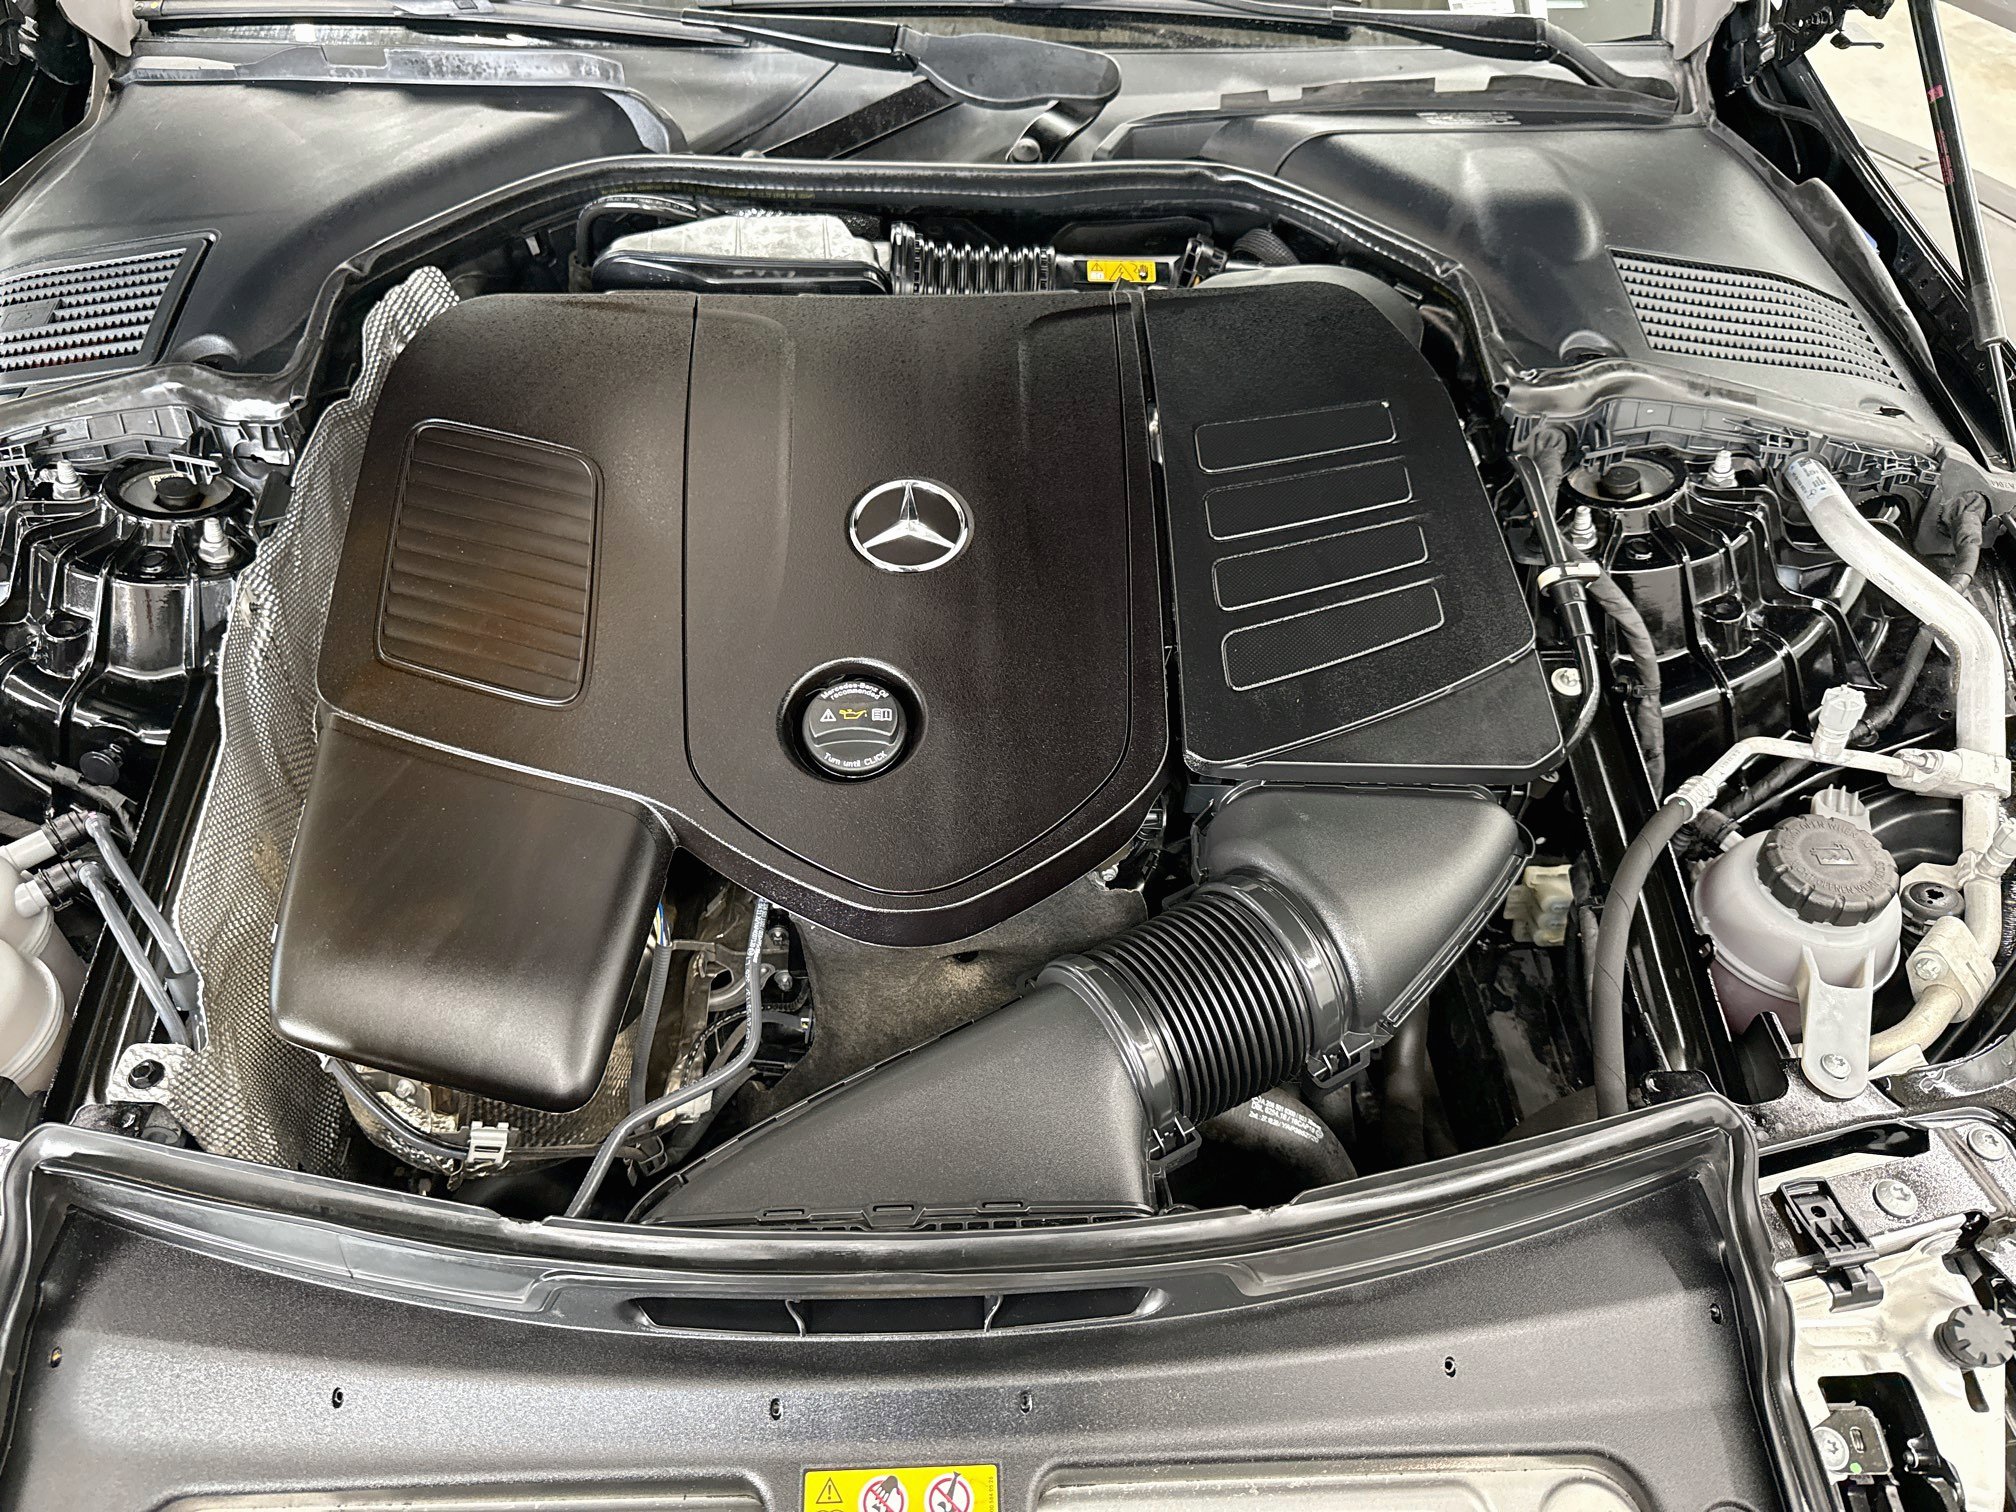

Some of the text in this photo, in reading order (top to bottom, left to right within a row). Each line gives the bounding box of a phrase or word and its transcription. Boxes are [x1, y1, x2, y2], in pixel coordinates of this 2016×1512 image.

[820, 682, 890, 699] Mercedes-Benz Oil
[830, 689, 881, 700] recommended
[823, 751, 887, 768] Turn until CLICK
